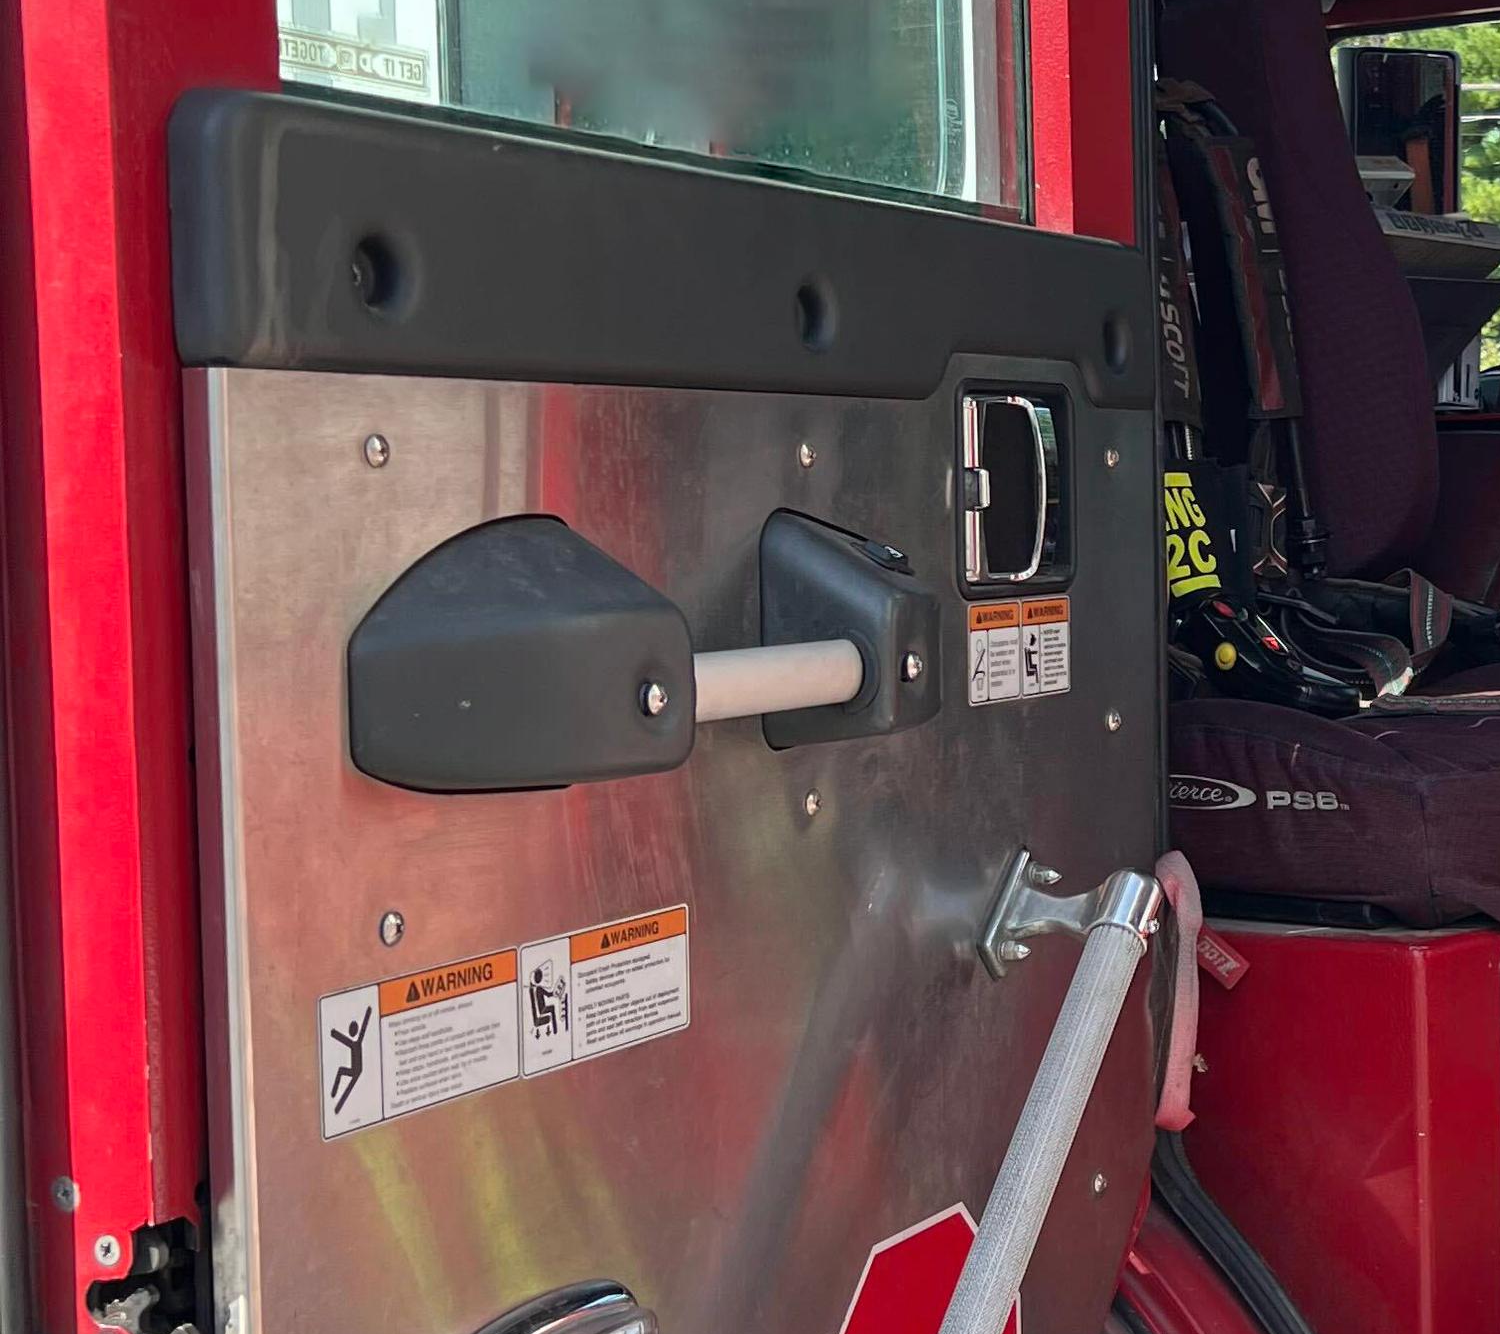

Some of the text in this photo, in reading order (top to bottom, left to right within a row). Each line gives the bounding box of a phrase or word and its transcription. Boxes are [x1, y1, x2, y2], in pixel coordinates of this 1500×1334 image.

[1164, 487, 1207, 532] NG
[981, 609, 1014, 623] WARNING
[1033, 605, 1064, 619] WARNING
[1167, 780, 1224, 803] ierce
[610, 920, 660, 945] WARNING
[421, 962, 494, 998] WARNING
